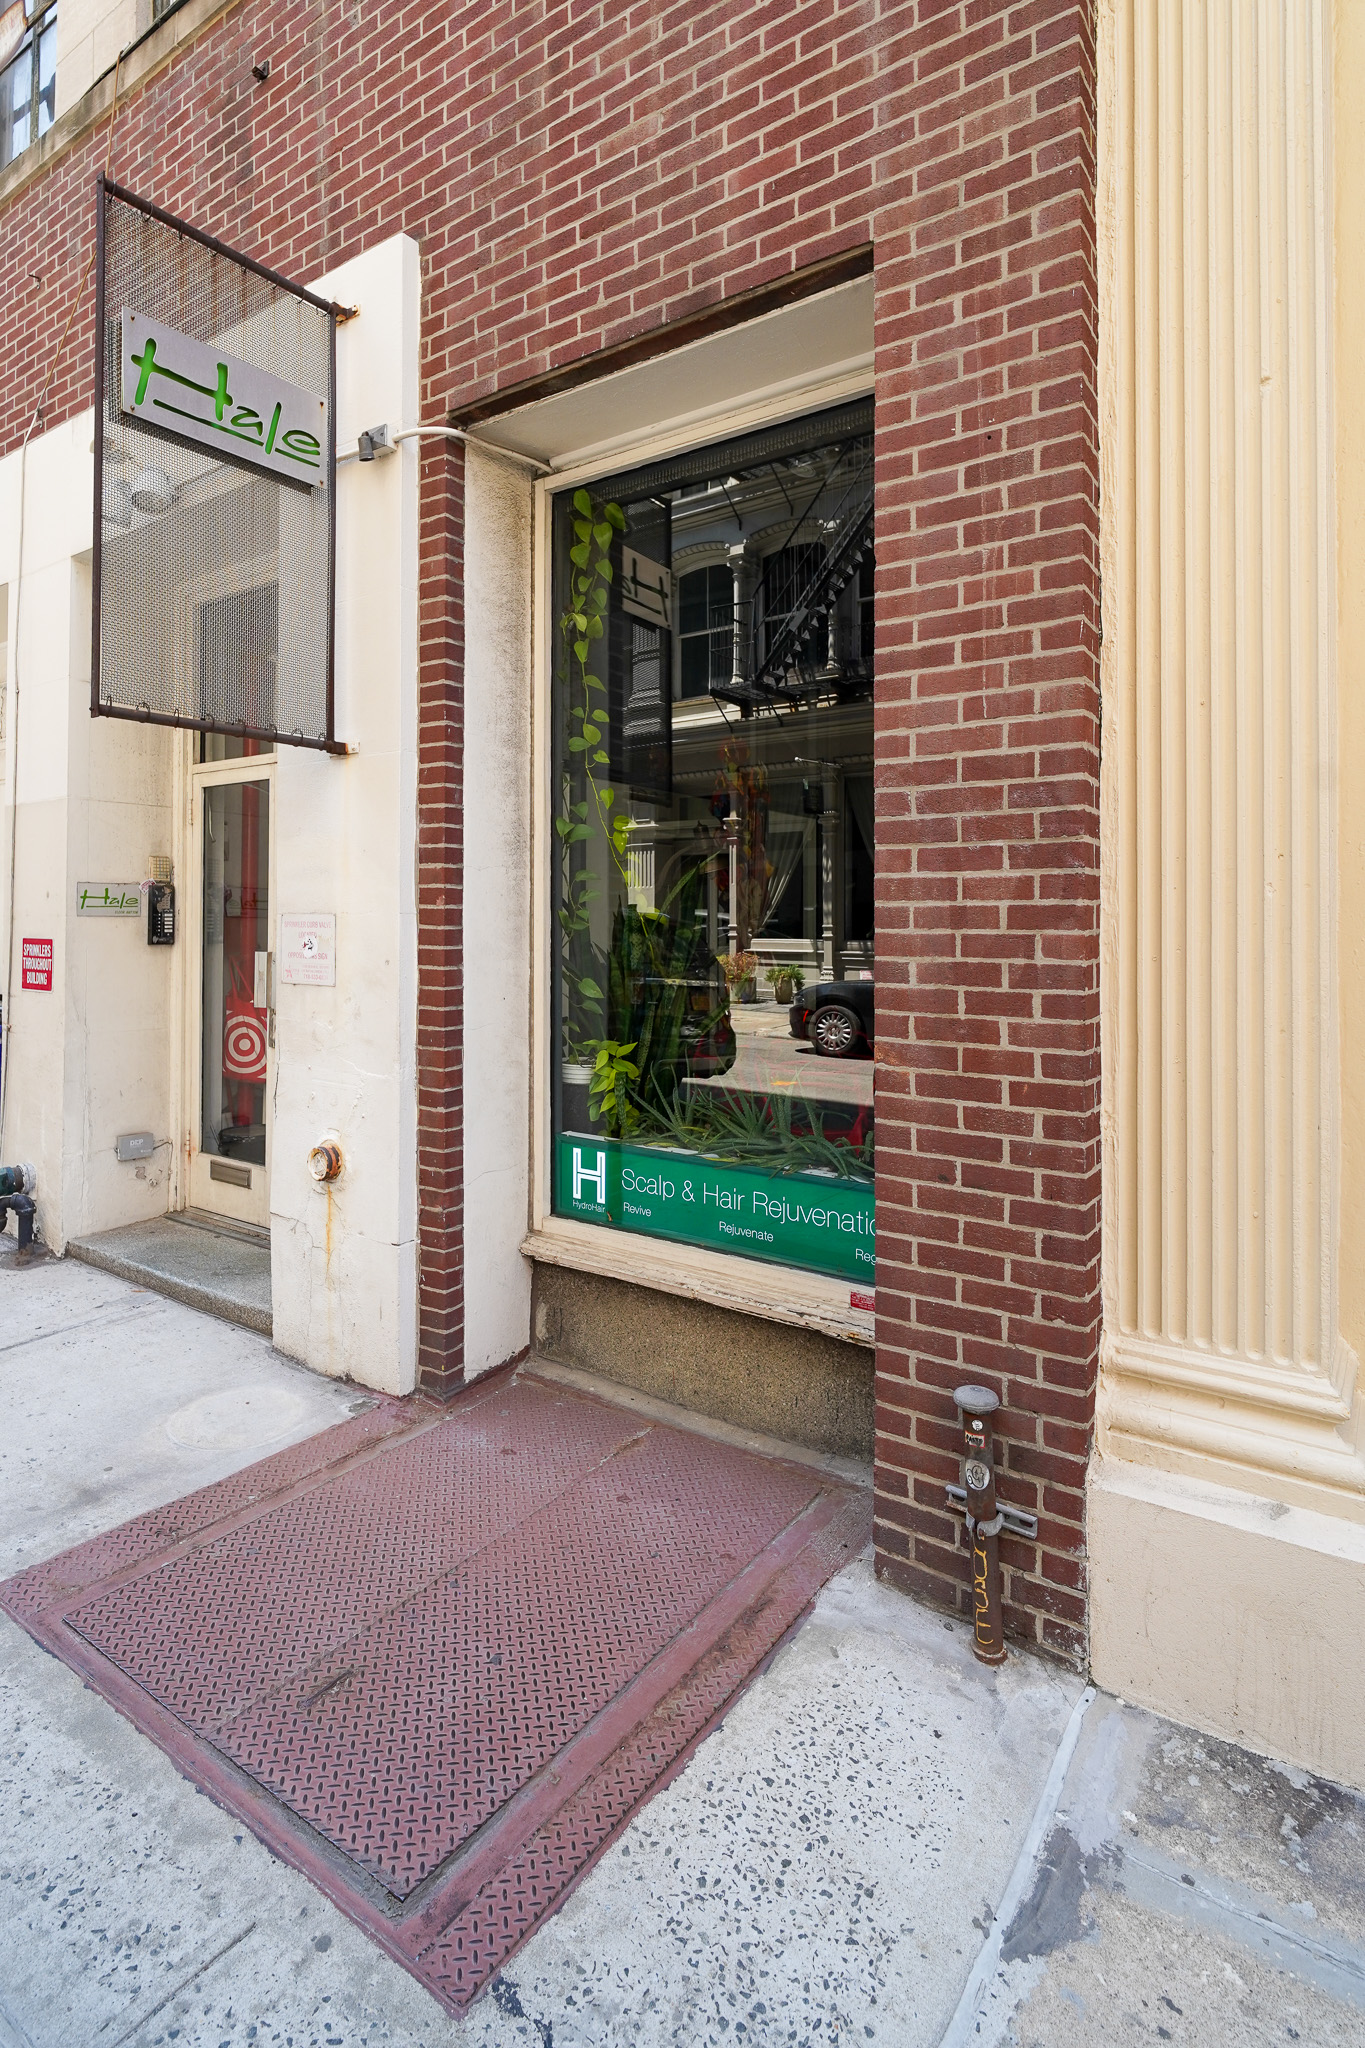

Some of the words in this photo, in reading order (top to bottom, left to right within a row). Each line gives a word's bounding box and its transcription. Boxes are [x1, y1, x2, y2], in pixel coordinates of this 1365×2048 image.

[130, 337, 321, 455] Hale
[80, 887, 139, 909] Hale
[23, 944, 51, 957] SPRINKLERS
[23, 957, 52, 971] THROUGHOUT
[26, 971, 48, 985] BUILDING
[622, 1168, 675, 1201] Scalp
[682, 1180, 696, 1202] &
[703, 1182, 745, 1210] Hair
[572, 1199, 606, 1213] HydroHair
[623, 1202, 652, 1217] Revive
[719, 1221, 774, 1242] Rejuvenate
